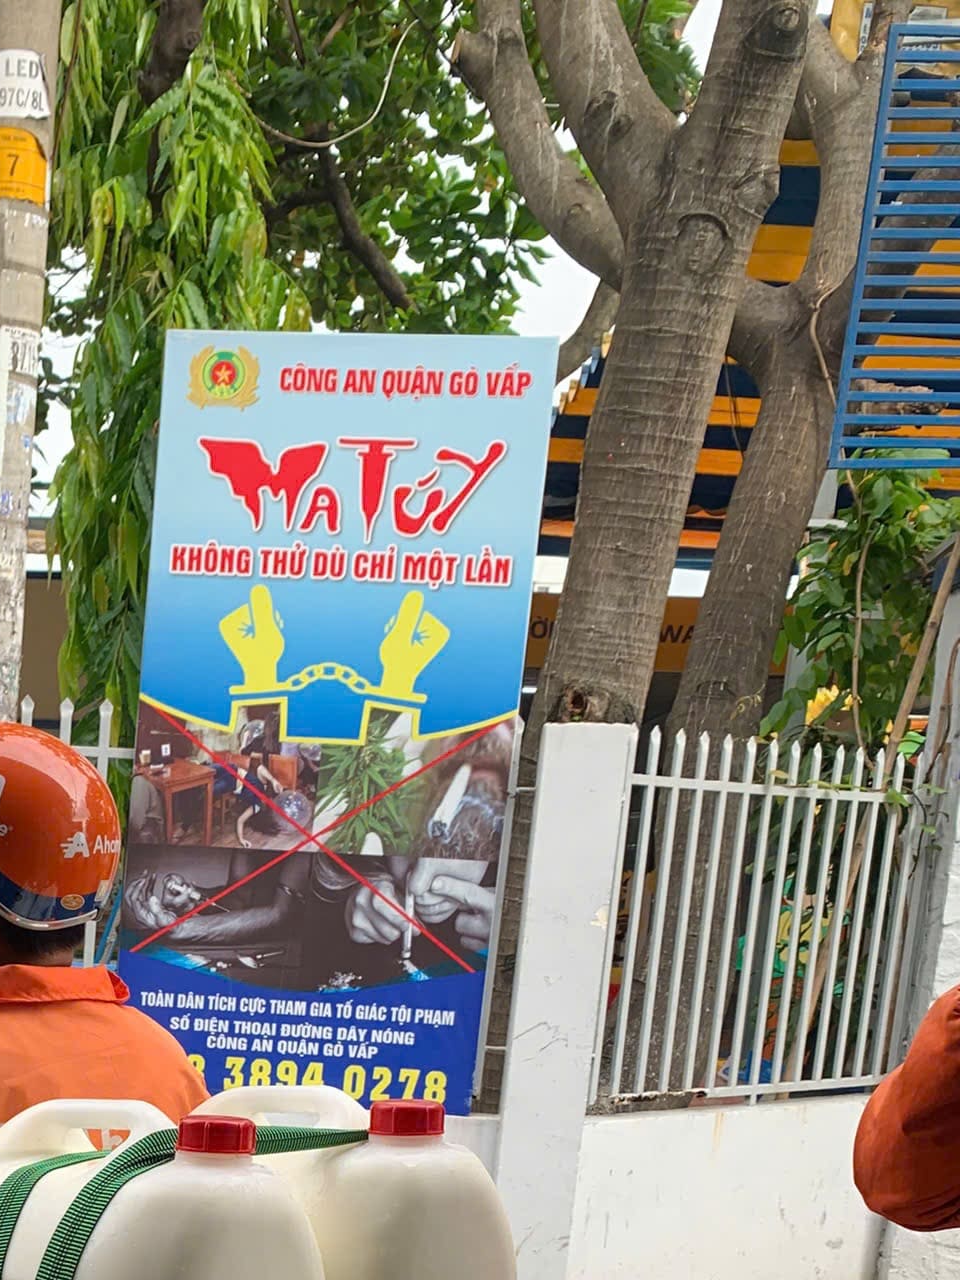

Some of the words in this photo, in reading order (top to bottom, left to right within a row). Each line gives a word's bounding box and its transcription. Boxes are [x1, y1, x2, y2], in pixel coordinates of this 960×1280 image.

[5, 58, 39, 79] LED
[7, 153, 19, 176] 7
[279, 362, 338, 393] CÔNG
[343, 369, 377, 394] AN
[382, 365, 444, 401] QUẬN
[449, 366, 479, 397] GÒ
[486, 362, 532, 397] VẤP
[198, 437, 340, 532] MA
[338, 437, 506, 543] TÚY
[170, 541, 252, 576] KHÔNG
[259, 543, 309, 578] THỬ
[312, 547, 346, 579] DÙ
[352, 544, 395, 581] CHỈ
[402, 549, 458, 589] MỘT
[464, 546, 512, 585] LẦN
[140, 989, 174, 1008] TOÀN
[177, 992, 204, 1010] DÂN
[208, 993, 236, 1011] TÍCH
[240, 997, 266, 1016] CỰC
[270, 999, 306, 1016] THAM
[310, 1002, 332, 1018] GIA
[336, 999, 353, 1019] TỐ
[356, 1003, 387, 1021] GIÁC
[391, 1004, 411, 1026] TỘI
[414, 1009, 455, 1028] PHẠM
[169, 1013, 191, 1030] SỐ
[194, 1017, 229, 1035] ĐIỆN
[233, 1020, 276, 1038] THOẠI
[280, 1022, 333, 1039] ĐƯỜNG
[337, 1025, 368, 1042] DÂY
[371, 1028, 415, 1046] NÓNG
[206, 1035, 248, 1051] CÔNG
[251, 1039, 272, 1053] AN
[277, 1039, 319, 1057] QUẬN
[323, 1041, 344, 1057] GÒ
[348, 1042, 378, 1059] VẤP
[223, 1056, 324, 1090] 3894
[343, 1064, 447, 1104] 0278
